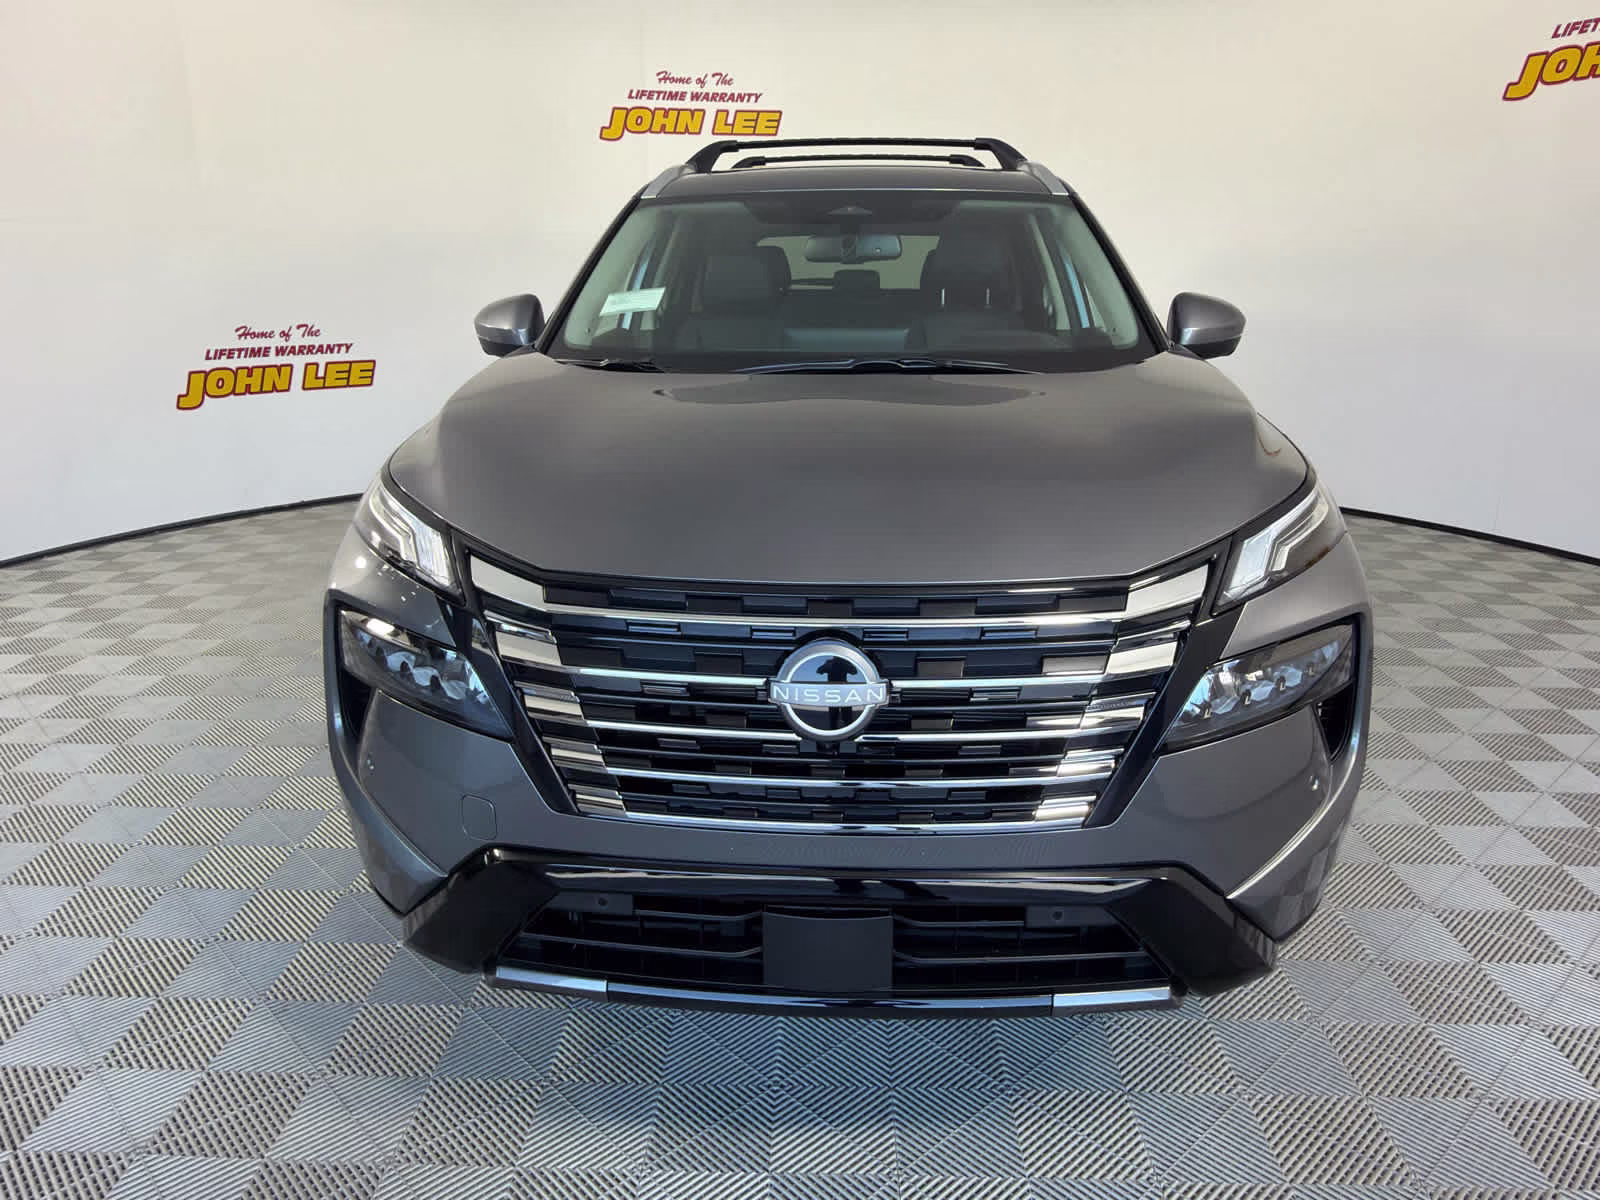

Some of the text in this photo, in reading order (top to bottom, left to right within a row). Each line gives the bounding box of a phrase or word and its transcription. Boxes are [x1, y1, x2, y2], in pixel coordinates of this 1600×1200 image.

[1551, 17, 1600, 39] LIFET
[656, 70, 734, 88] Home of The
[627, 89, 762, 103] LIFETIME WARRANTY
[599, 106, 783, 141] JOHN LEE
[234, 323, 321, 342] Home of The
[204, 343, 354, 361] LIFETIME WARRANTY
[176, 359, 376, 410] JOHN LEE
[773, 686, 884, 703] NISSAN
